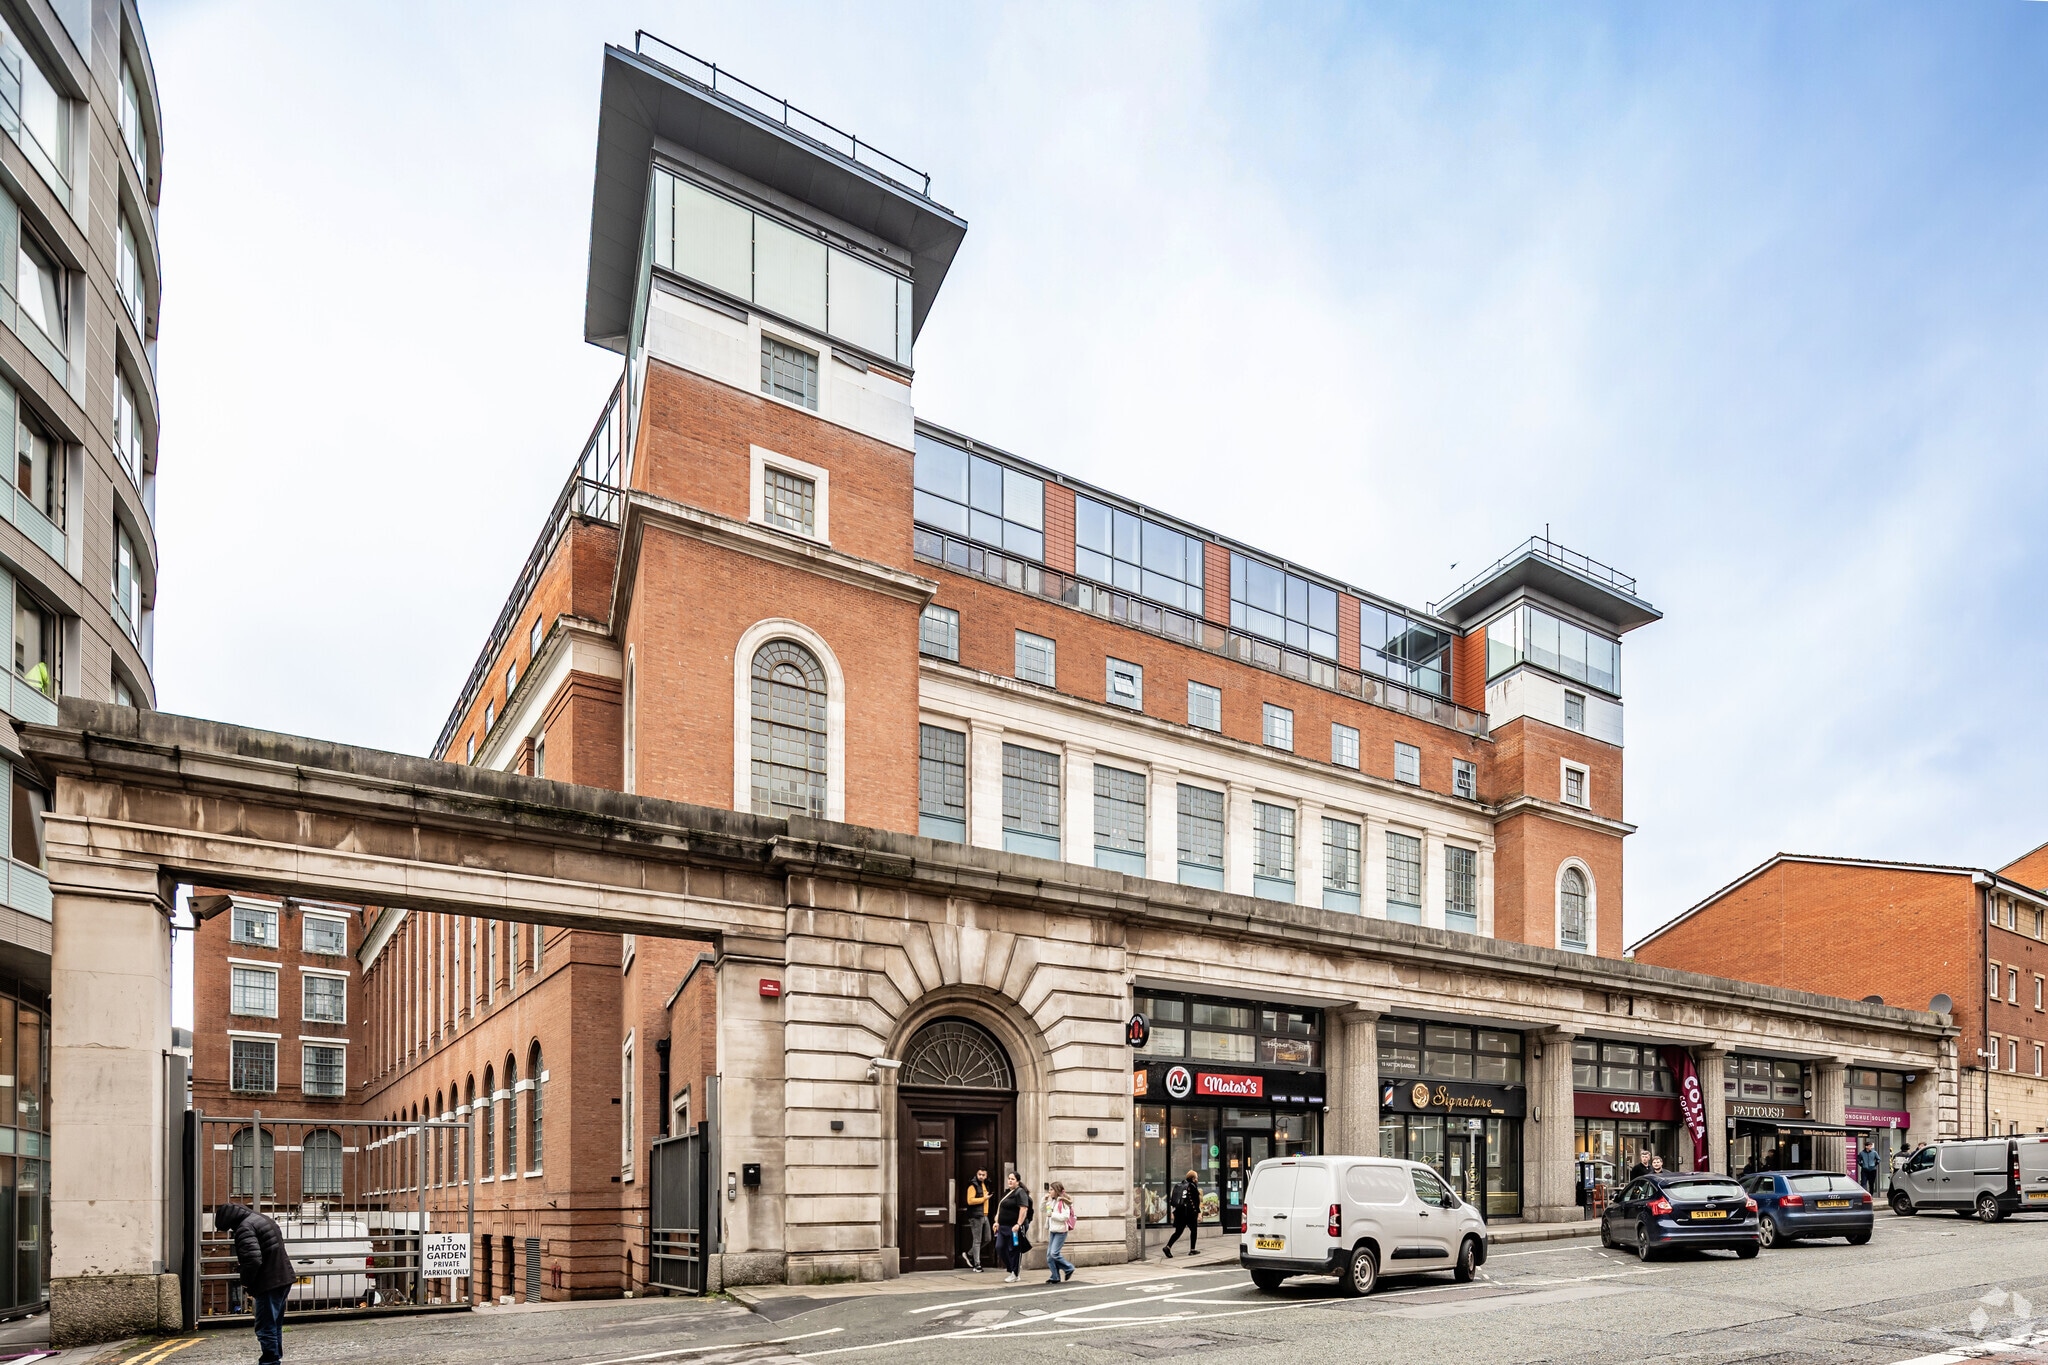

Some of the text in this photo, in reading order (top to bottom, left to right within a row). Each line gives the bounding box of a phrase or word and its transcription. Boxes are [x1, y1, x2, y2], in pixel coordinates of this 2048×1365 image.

[1204, 1076, 1258, 1094] Matar's
[1432, 1085, 1494, 1113] Signature
[1610, 1100, 1641, 1114] COSTA
[1685, 1076, 1705, 1139] COSTA
[1680, 1095, 1695, 1128] COFFEE
[1733, 1105, 1785, 1118] FATTOUSH
[1871, 1115, 1901, 1123] SOLICITORS
